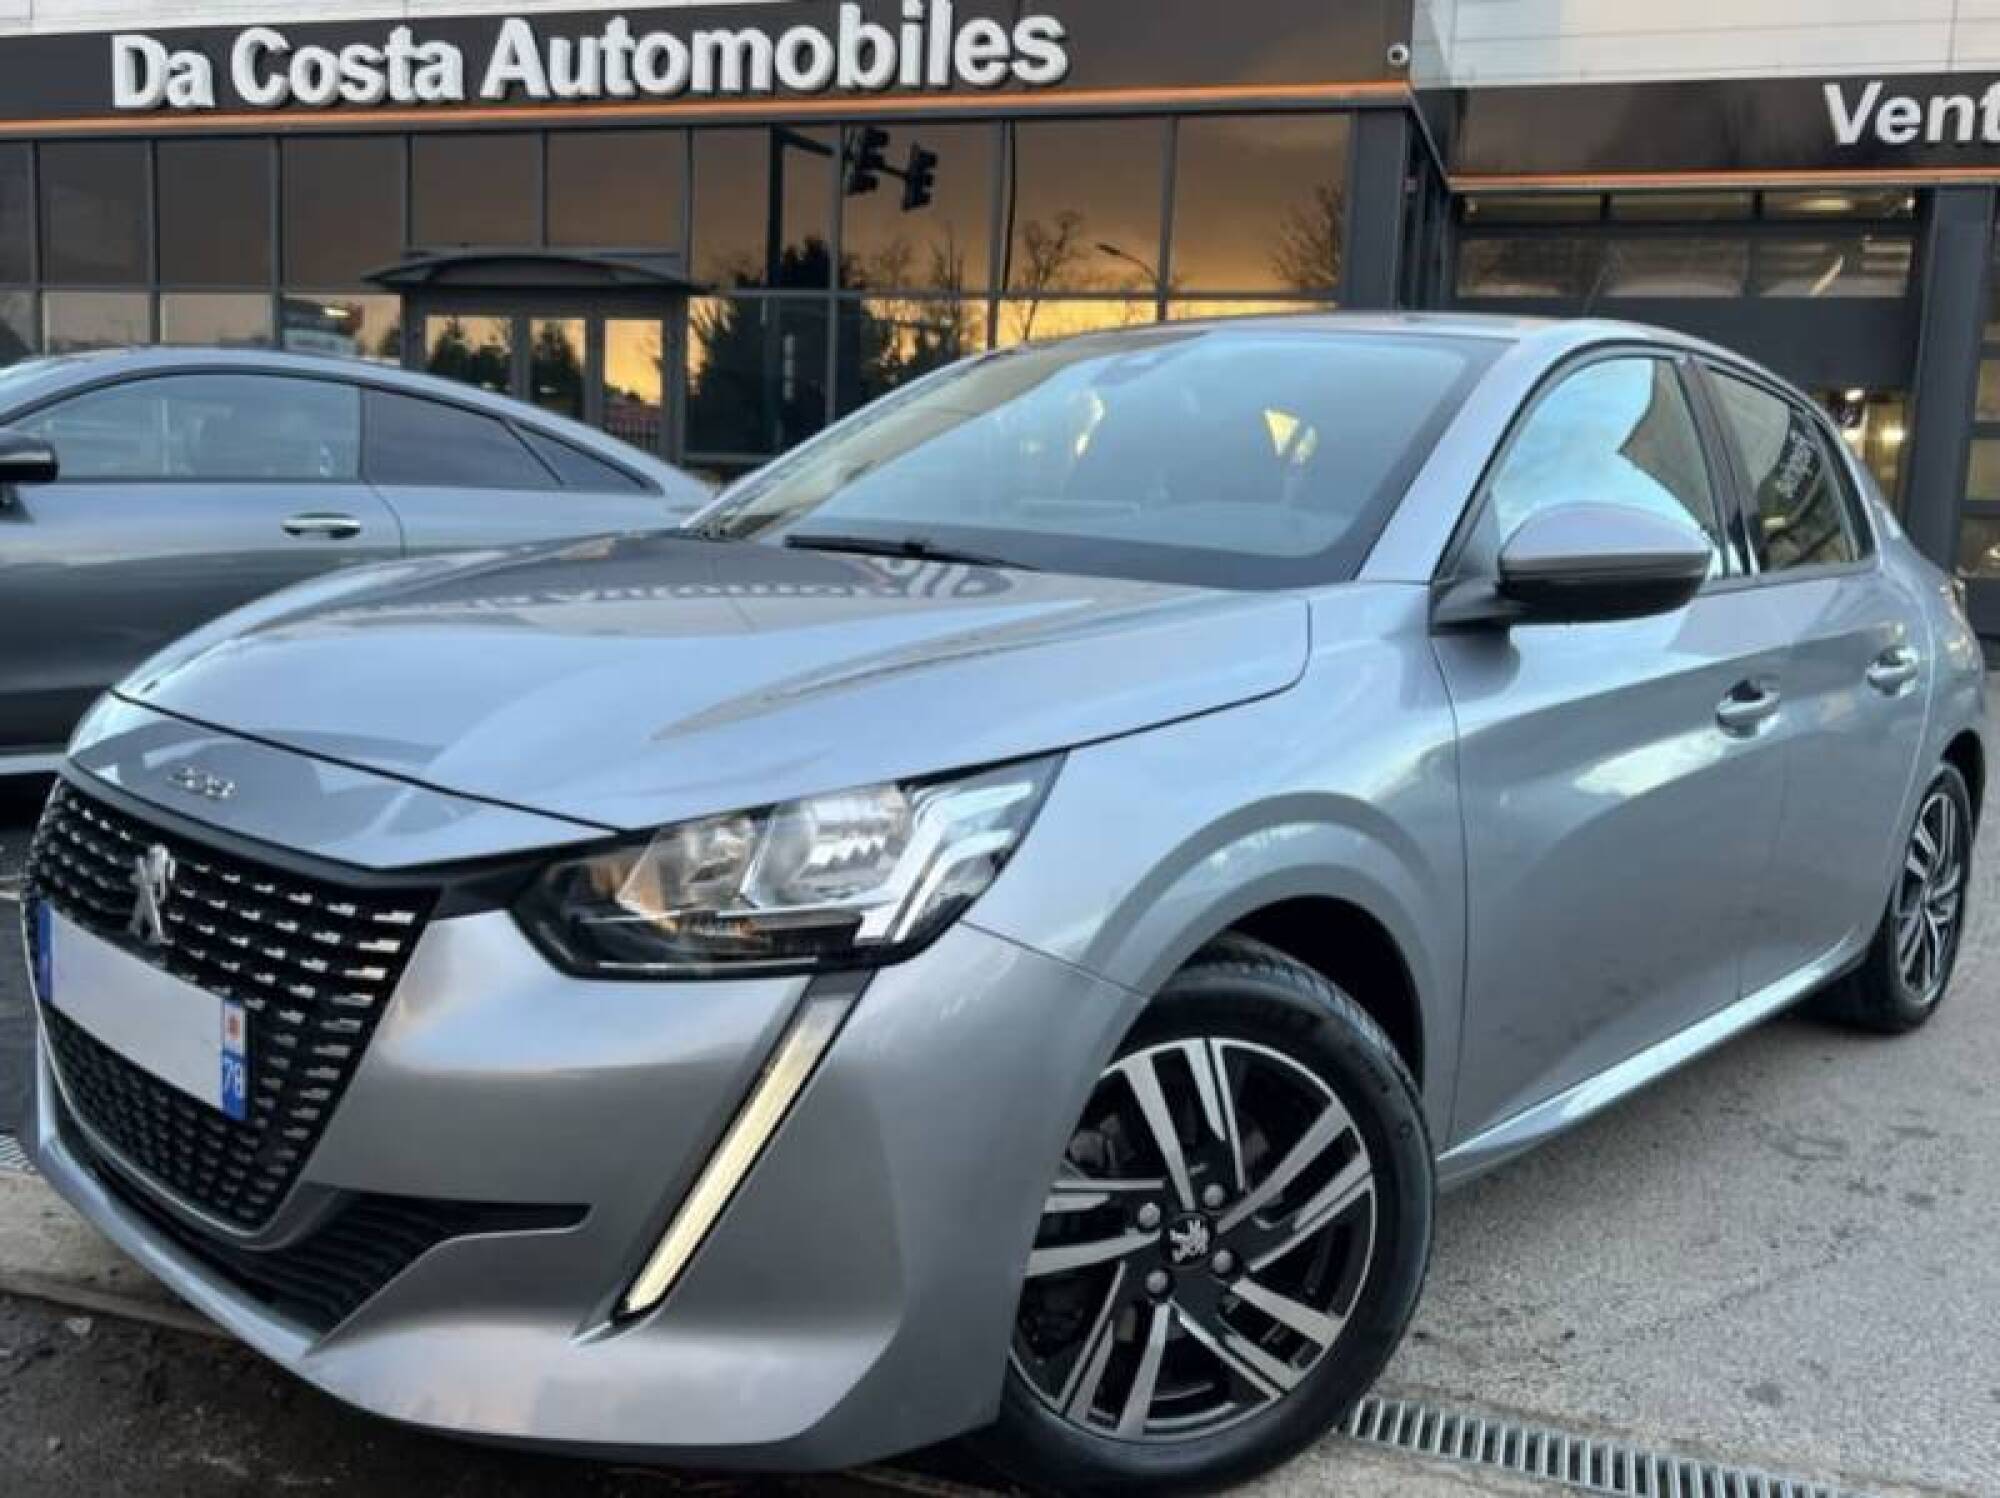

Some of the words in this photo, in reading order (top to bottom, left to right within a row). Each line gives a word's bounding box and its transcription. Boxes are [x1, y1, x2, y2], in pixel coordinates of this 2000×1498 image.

[112, 34, 215, 108] Da
[231, 25, 464, 105] Costa
[480, 0, 1068, 98] Automobiles
